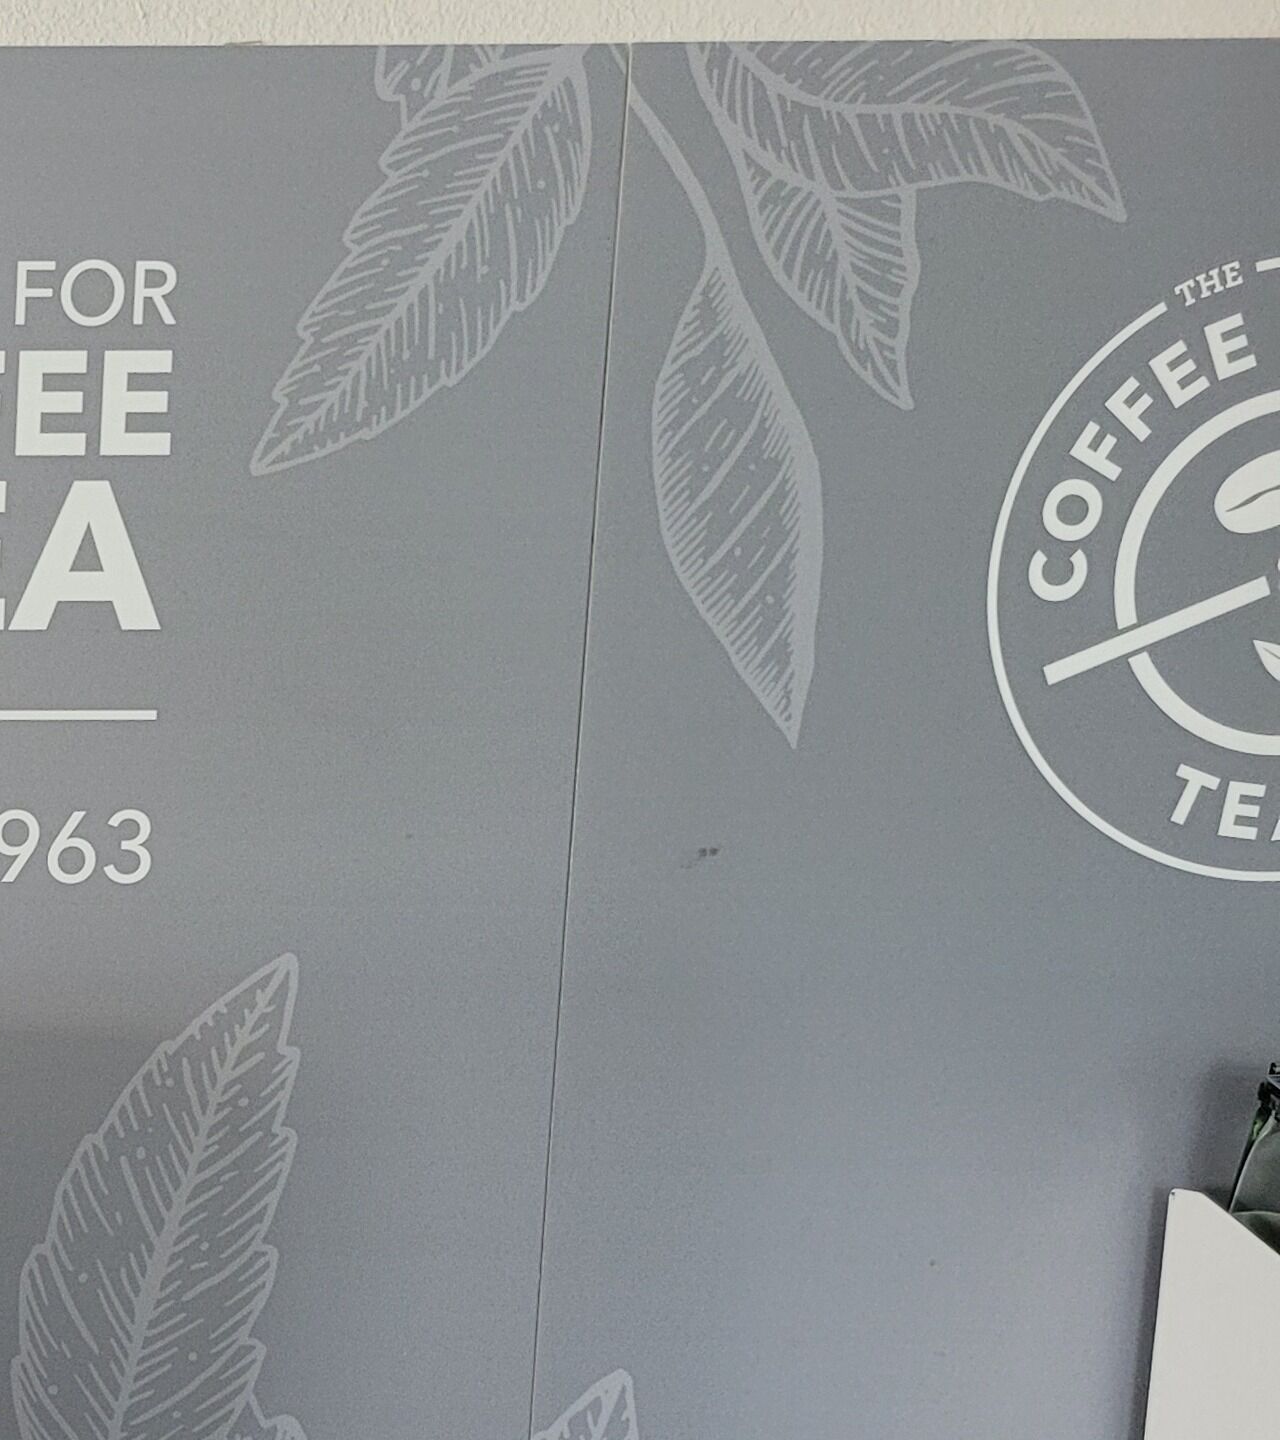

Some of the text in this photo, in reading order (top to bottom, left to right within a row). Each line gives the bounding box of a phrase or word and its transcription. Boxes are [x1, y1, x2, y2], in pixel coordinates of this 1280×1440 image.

[14, 259, 178, 327] FOR
[1174, 261, 1244, 307] THE
[1028, 312, 1258, 602] COFFEE
[1169, 763, 1280, 842] TE
